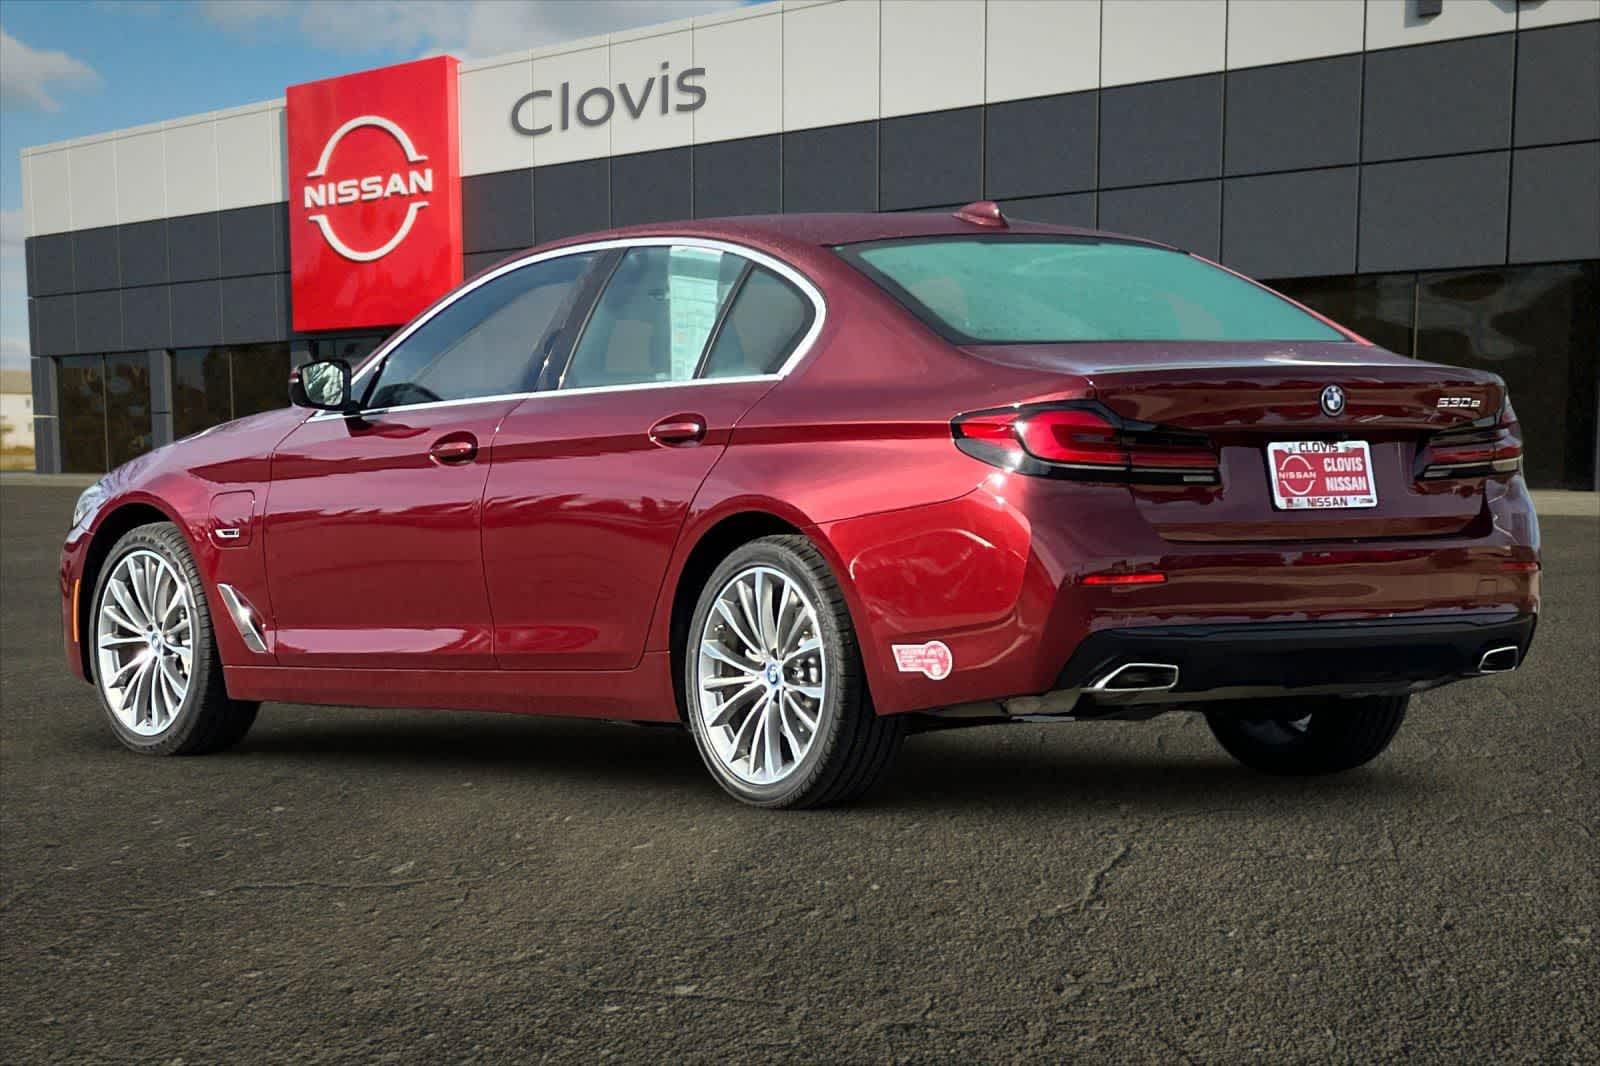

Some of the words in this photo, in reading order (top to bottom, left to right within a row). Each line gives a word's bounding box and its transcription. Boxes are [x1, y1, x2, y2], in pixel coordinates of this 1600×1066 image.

[511, 62, 707, 136] Clovis
[304, 168, 432, 208] NISSAN
[1437, 397, 1481, 408] 530e
[1299, 442, 1339, 453] CLOVIS
[1323, 457, 1363, 472] CLOVIS
[1279, 471, 1317, 480] NISSAN
[1325, 476, 1367, 491] NISSAN
[1307, 497, 1348, 507] NISSAN
